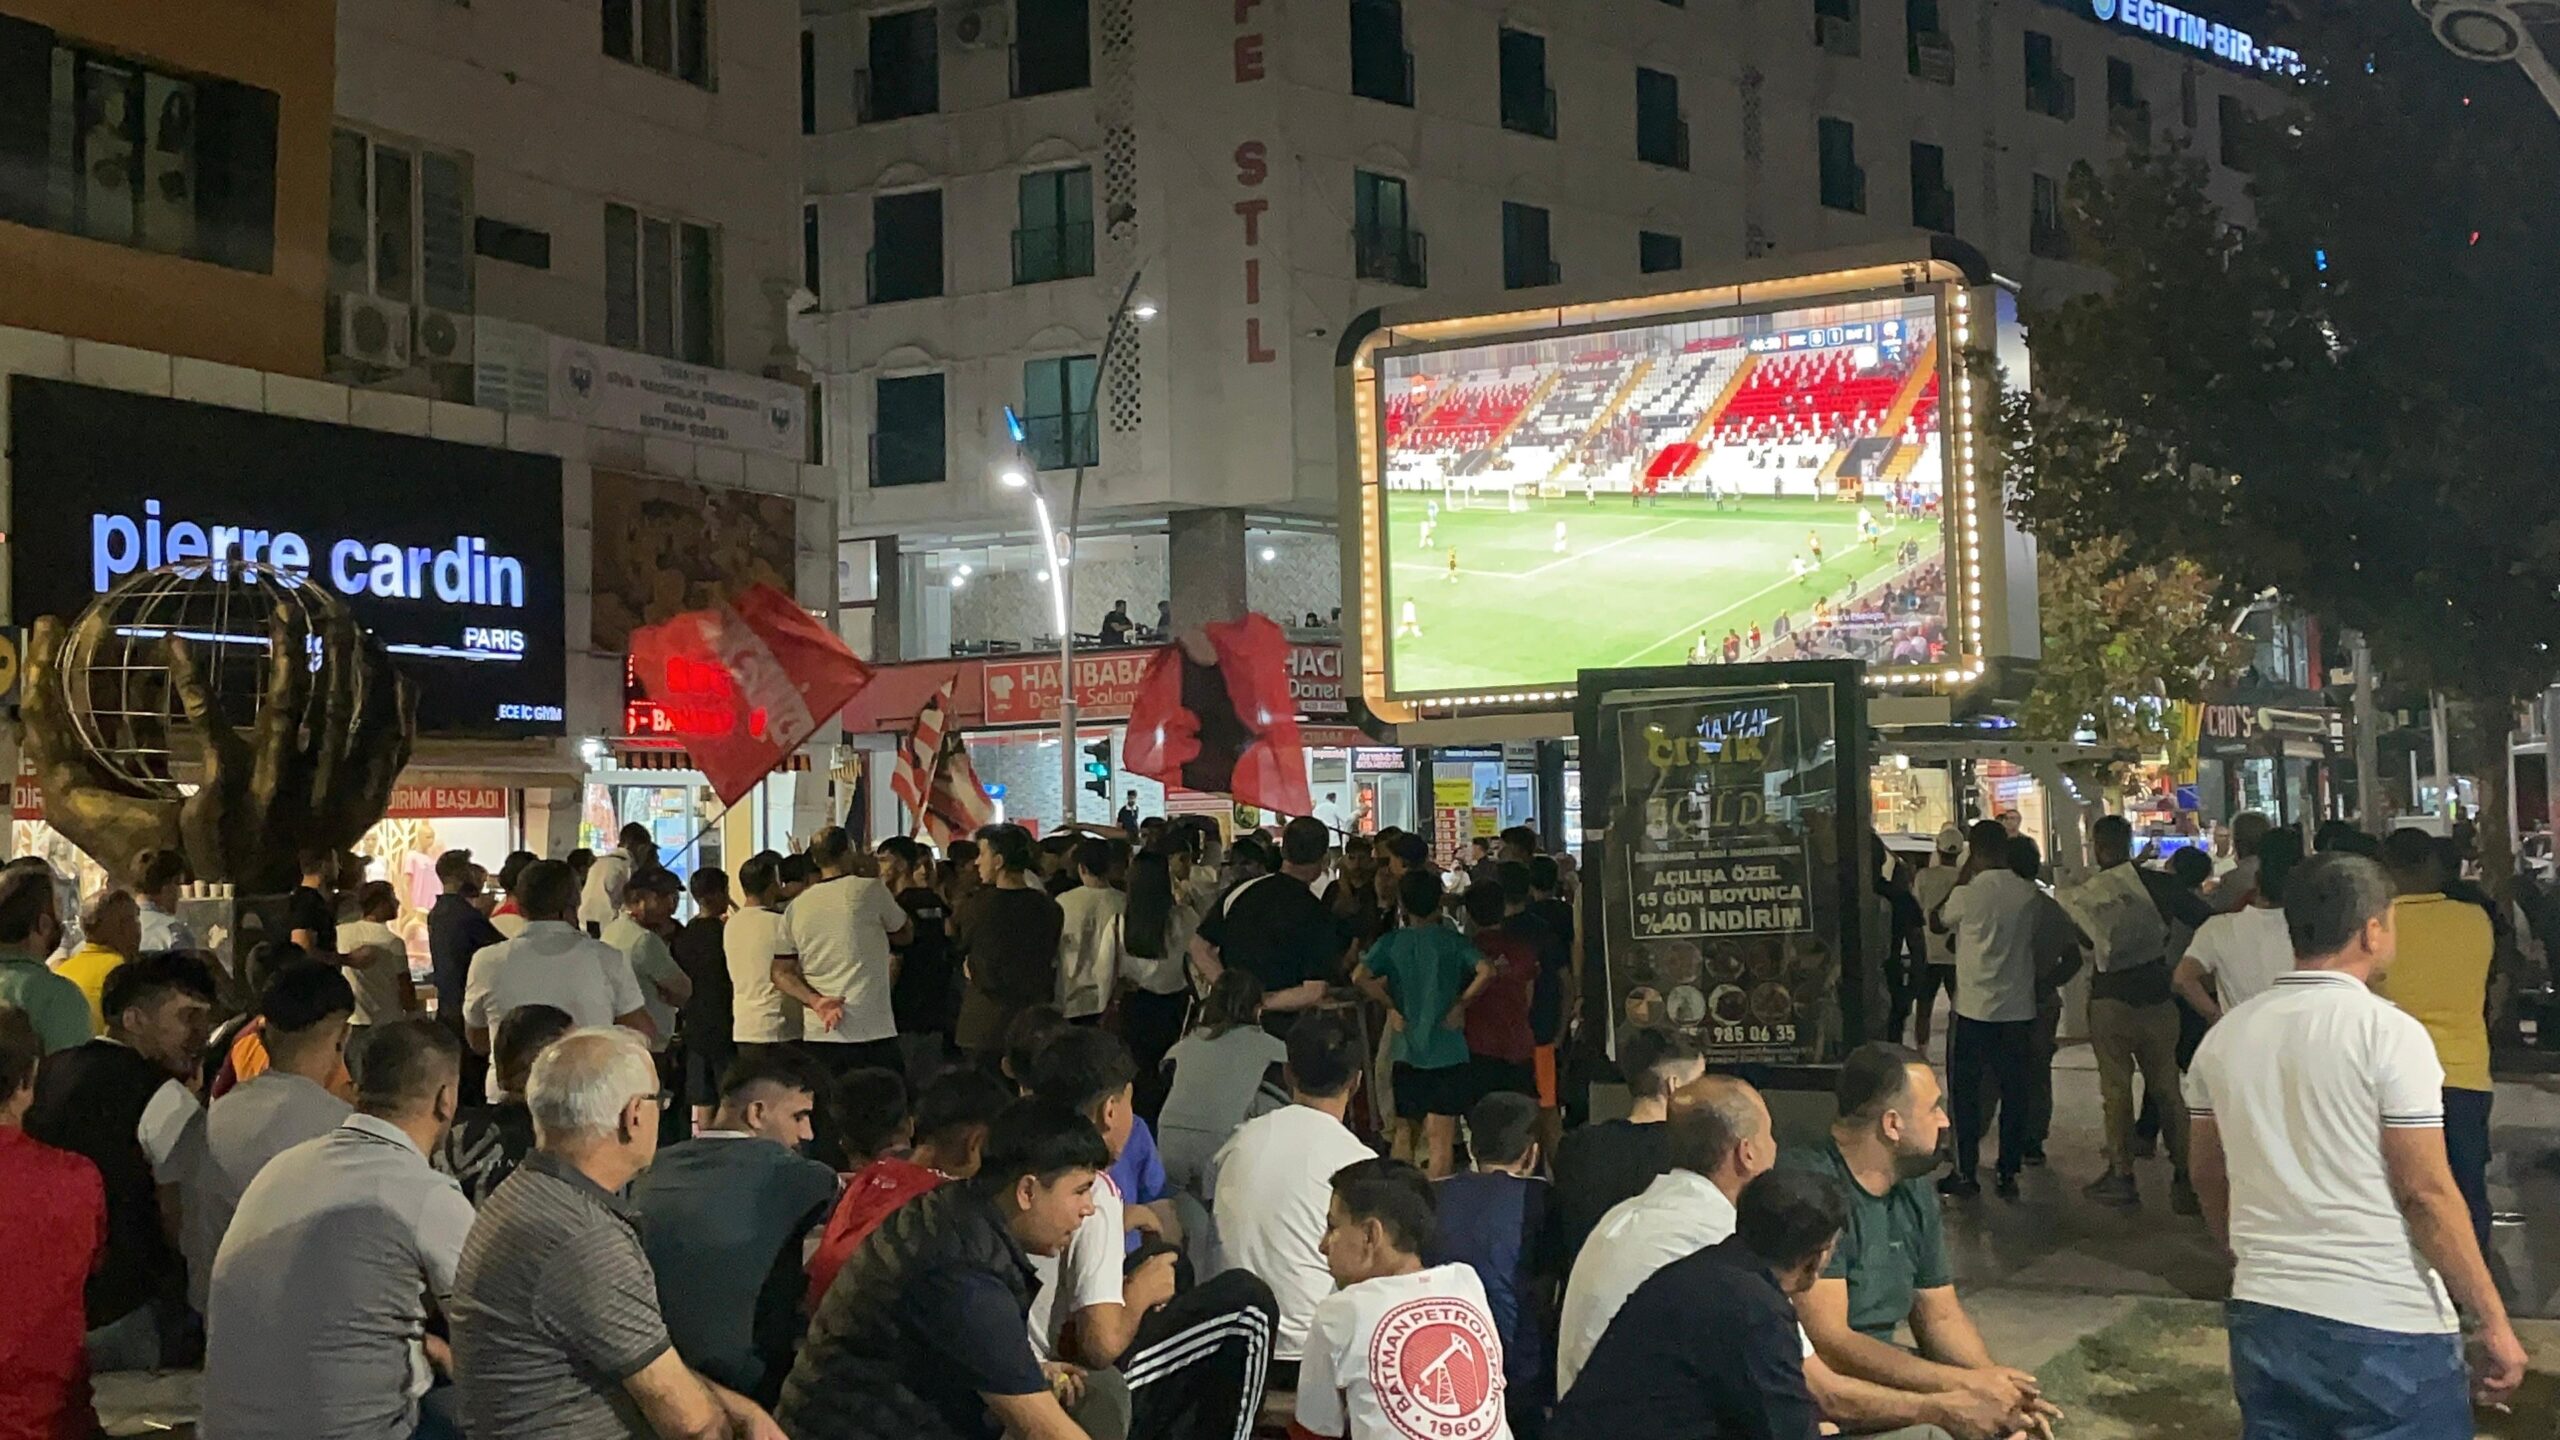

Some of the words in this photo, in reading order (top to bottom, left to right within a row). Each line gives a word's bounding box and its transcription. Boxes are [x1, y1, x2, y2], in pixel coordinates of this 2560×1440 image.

[92, 498, 310, 593] pierre
[330, 535, 524, 608] cardin
[464, 627, 525, 652] PARIS
[1021, 659, 1148, 690] HAIBABA
[499, 704, 520, 719] ECE
[435, 788, 500, 810] BAŞLADI
[1654, 869, 1727, 888] AÇILIŞA
[1732, 864, 1781, 882] ÖZEL
[1637, 892, 1658, 907] 15
[1663, 888, 1704, 906] GÜN
[1709, 885, 1803, 904] BOYUNCA
[1640, 911, 1692, 934] %40
[1700, 903, 1802, 932] İNDİRİM
[1750, 1025, 1770, 1042] 06
[1776, 1024, 1796, 1042] 35
[1382, 1319, 1413, 1414] BATMAN
[1429, 1417, 1482, 1437] 1960
